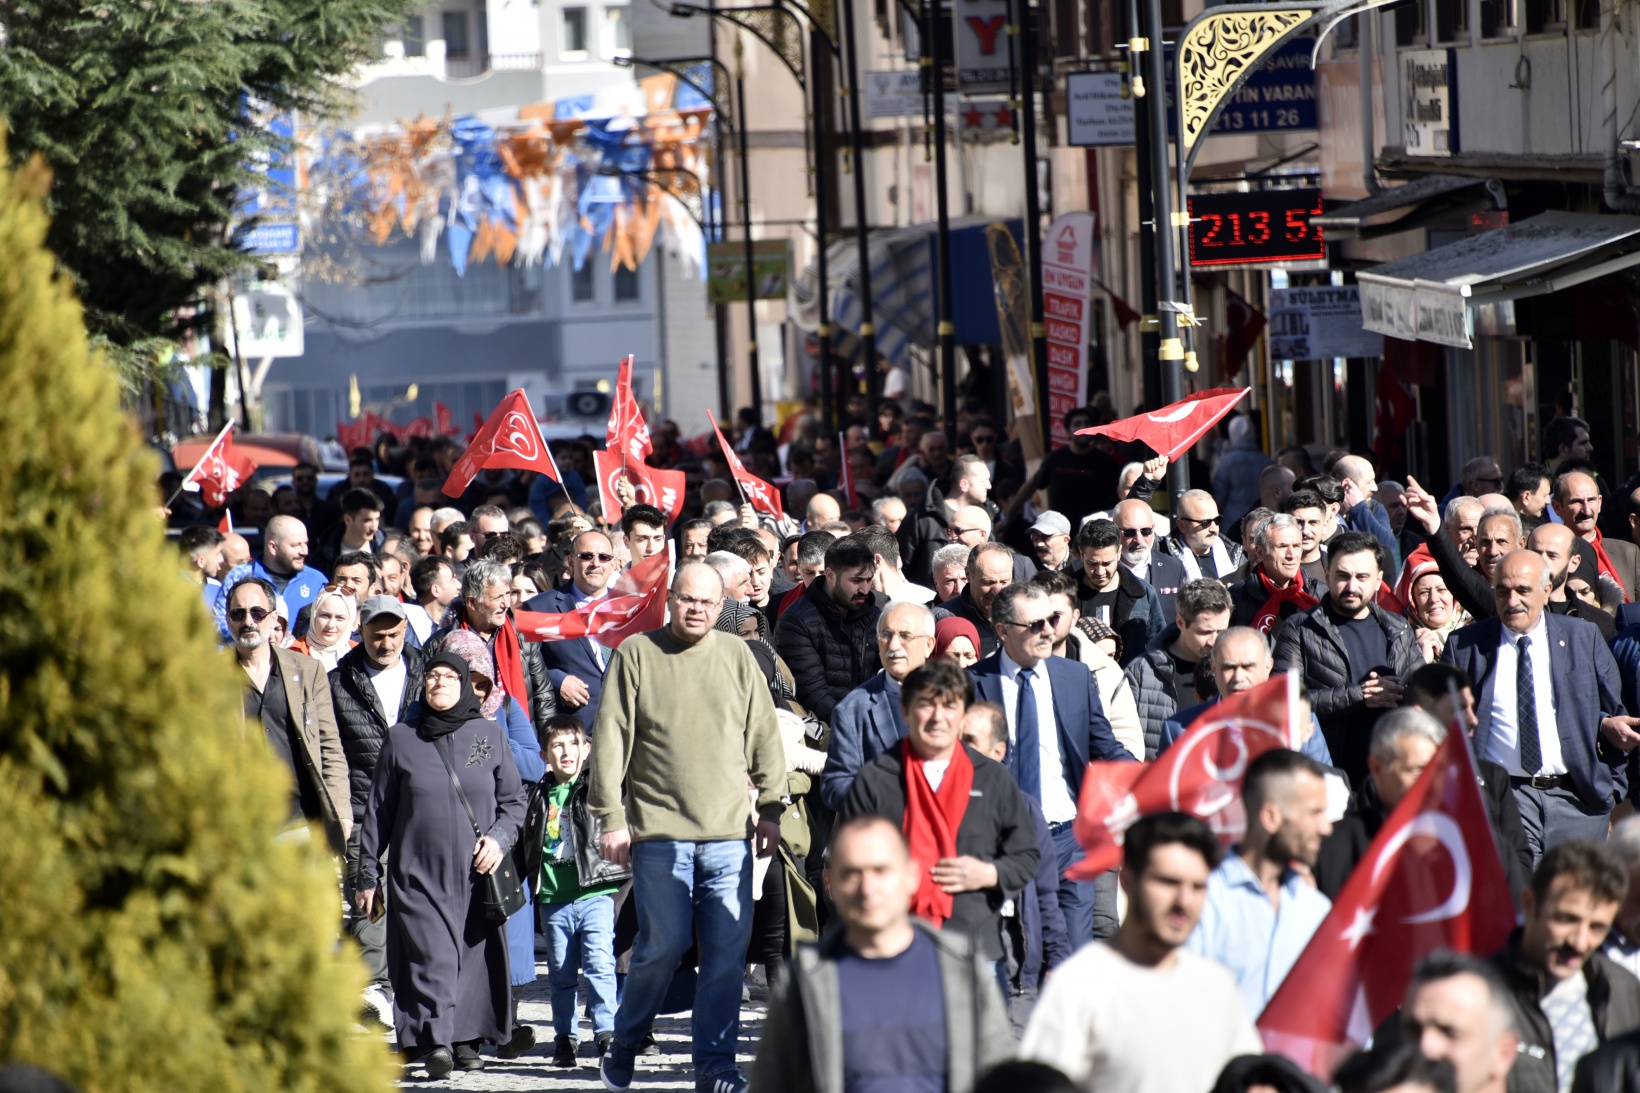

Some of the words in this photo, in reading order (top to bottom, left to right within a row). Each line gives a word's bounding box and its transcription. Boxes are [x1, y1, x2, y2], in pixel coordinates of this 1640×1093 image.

[1230, 87, 1260, 104] TİN
[1262, 84, 1315, 102] VARAN
[1249, 111, 1270, 128] 11
[1276, 109, 1300, 126] 26
[1201, 211, 1271, 246] 213
[1044, 269, 1055, 284] EN
[1057, 273, 1086, 290] UYGUN
[1289, 290, 1359, 305] SÜLEYMA
[1049, 298, 1080, 319] TRAFİK
[1049, 323, 1078, 342] KASKO
[1050, 347, 1075, 365] DASK
[1048, 371, 1075, 390] ANGIN
